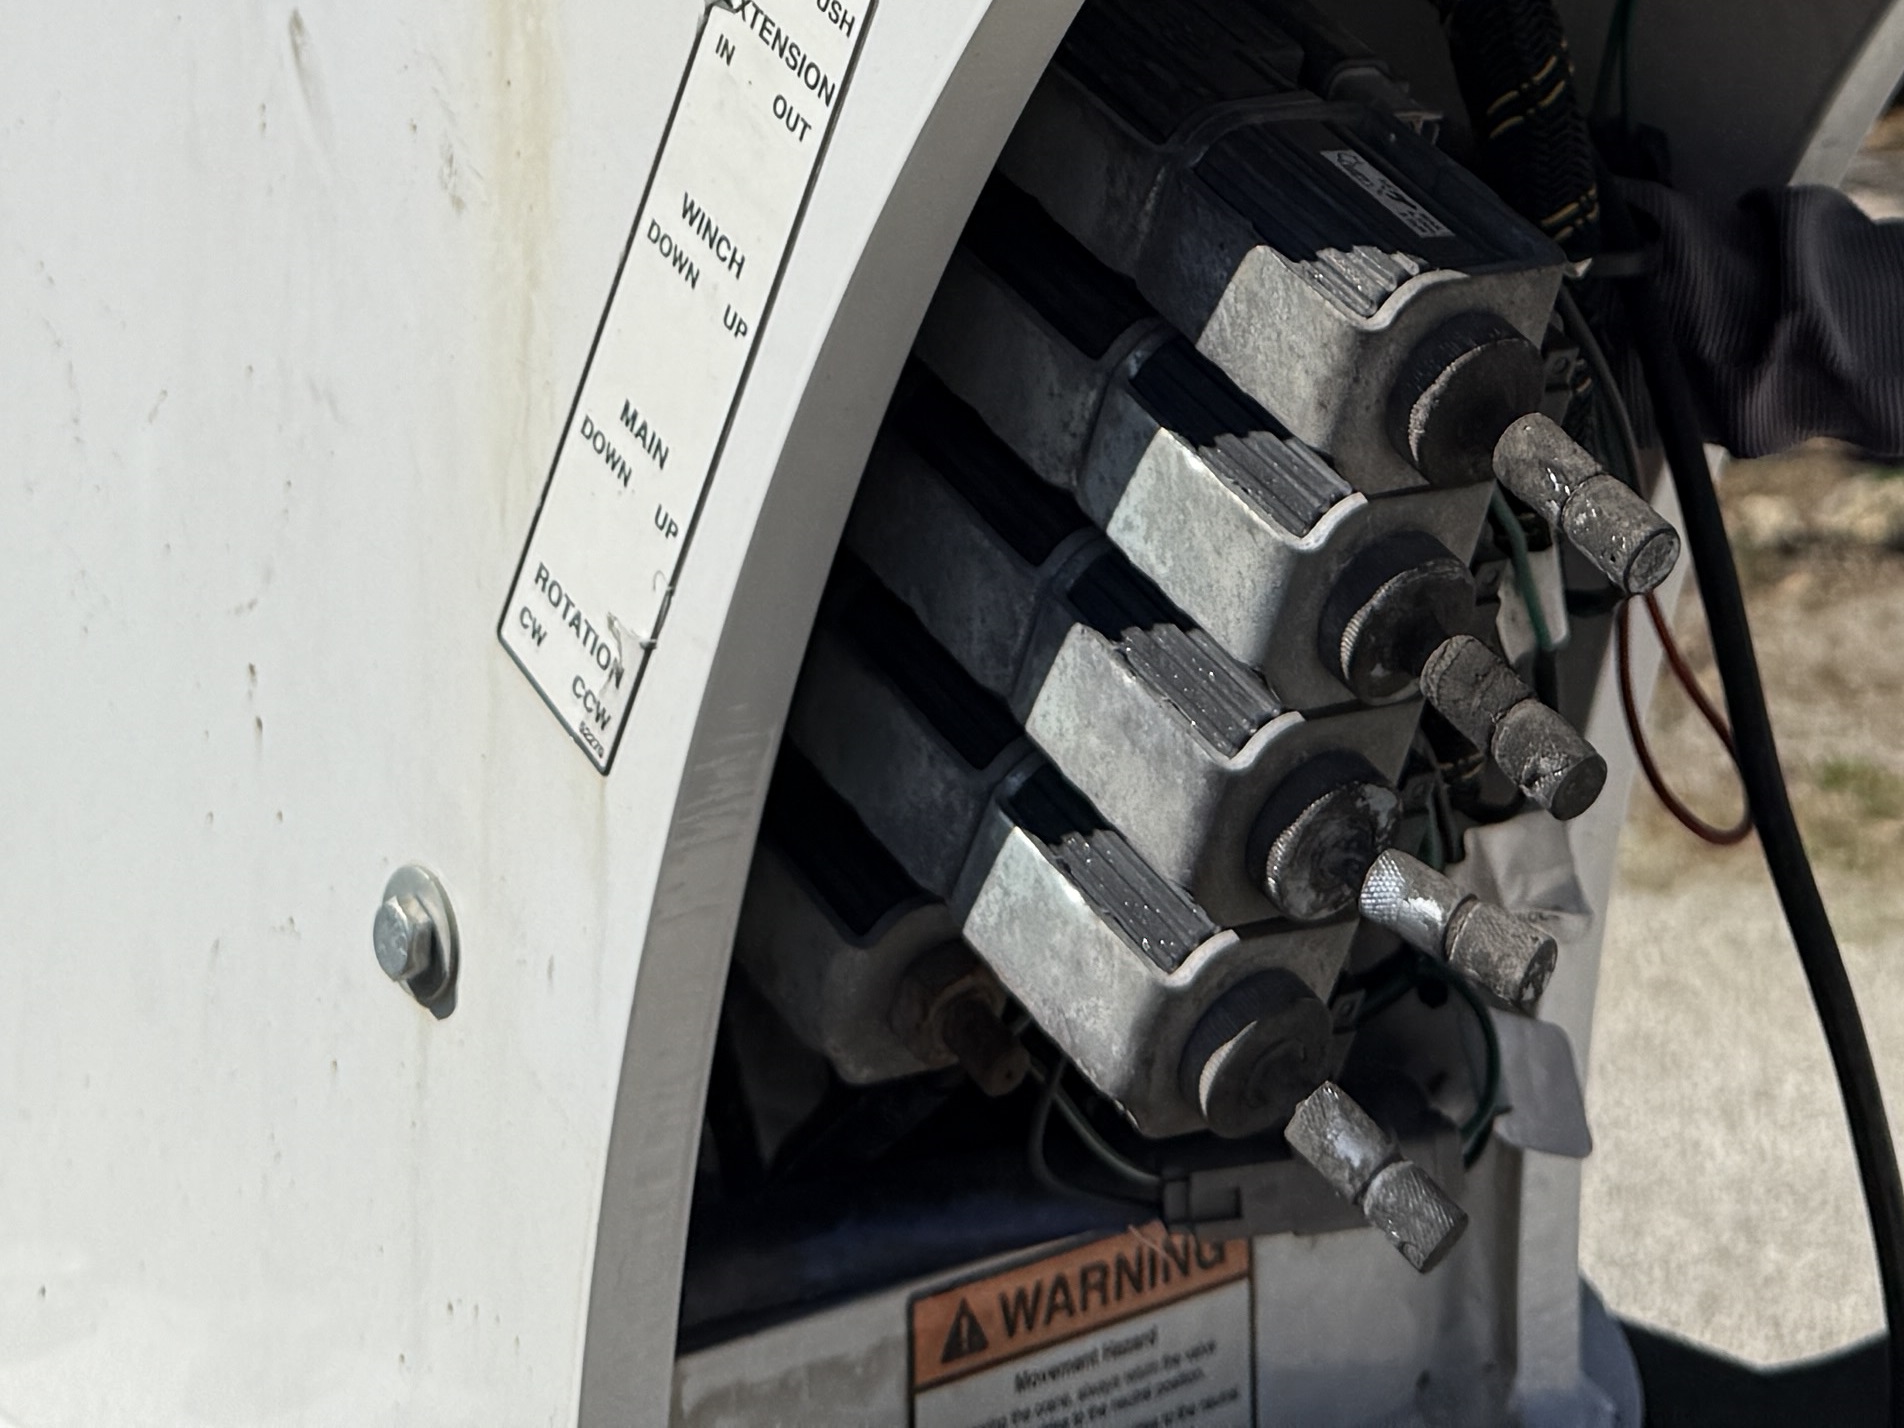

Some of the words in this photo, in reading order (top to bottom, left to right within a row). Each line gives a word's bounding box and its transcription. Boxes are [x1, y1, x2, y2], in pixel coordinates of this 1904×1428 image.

[715, 32, 736, 67] IN
[772, 94, 812, 143] OUT
[647, 218, 700, 290] DOWN
[723, 304, 748, 342] UP
[681, 191, 746, 281] WINCH
[580, 414, 632, 489] DOWN
[654, 504, 679, 541] UP
[620, 398, 670, 471] MAIN
[519, 605, 548, 648] CW
[571, 675, 611, 732] CCW
[534, 561, 626, 690] ROTATION
[998, 1232, 1227, 1339] WARNING
